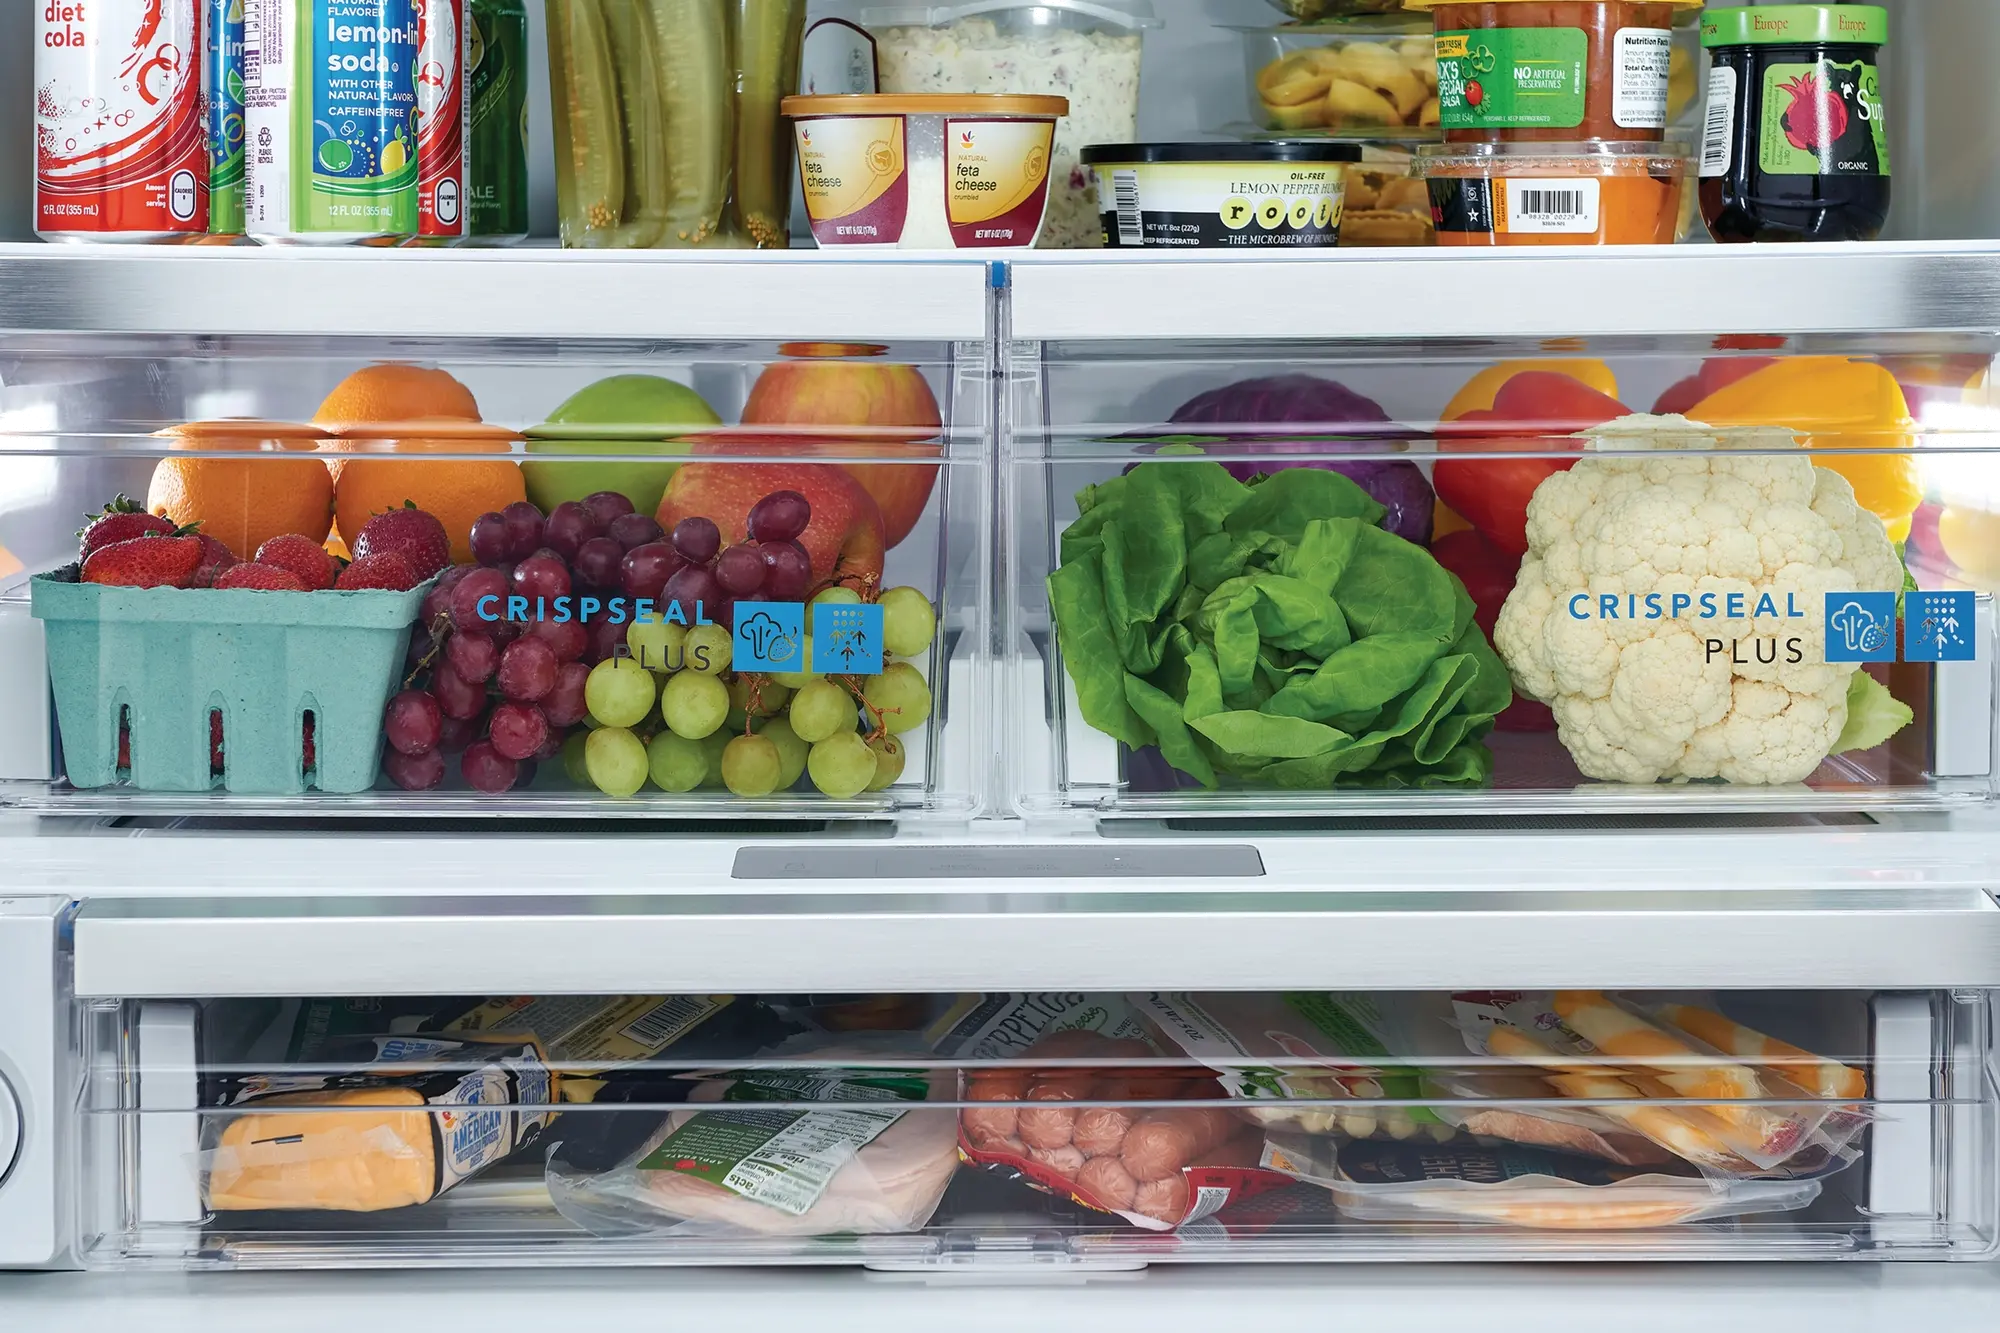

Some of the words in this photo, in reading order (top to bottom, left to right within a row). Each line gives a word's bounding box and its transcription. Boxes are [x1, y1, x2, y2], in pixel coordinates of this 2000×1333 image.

[45, 0, 85, 22] diet
[1754, 15, 1789, 35] Europe
[1838, 14, 1866, 36] Europe
[45, 24, 85, 47] cola
[1625, 37, 1656, 45] Nutrition
[327, 48, 389, 72] soda
[1514, 66, 1531, 80] NO
[1533, 69, 1566, 80] ARTIFICIAL
[328, 79, 358, 88] WITH
[360, 80, 393, 89] OTHER
[1518, 79, 1562, 89] PRESERVATIVES
[328, 91, 380, 100] NATURAL
[1442, 96, 1461, 107] SALSA
[328, 106, 381, 116] CAFFEINE
[384, 108, 404, 117] FREE
[805, 161, 822, 173] feta
[957, 163, 979, 176] feta
[1837, 162, 1868, 170] ORGANIC
[807, 174, 842, 187] cheese
[1290, 172, 1325, 180] OIL-FREE
[955, 178, 997, 191] cheese
[1230, 182, 1279, 194] LEMON
[1282, 183, 1320, 195] PEPPER
[43, 205, 49, 214] 12
[49, 205, 56, 214] FL
[56, 205, 65, 214] OZ
[66, 205, 82, 216] (355
[83, 205, 99, 216] mL)
[329, 206, 338, 216] 12
[339, 206, 349, 216] FL
[351, 206, 362, 216] OZ
[363, 205, 380, 217] (355
[1181, 225, 1200, 233] (227g)
[1156, 237, 1200, 245] REFRIGERATED
[1228, 235, 1247, 245] THE
[1249, 235, 1304, 245] MICROBREW
[476, 594, 713, 626] CRISPSEAL
[1568, 592, 1806, 620] CRISPSEAL
[612, 643, 711, 672] PLUS
[1705, 638, 1804, 665] PLUS
[453, 1110, 501, 1154] AMERICAN
[753, 1151, 775, 1160] 50
